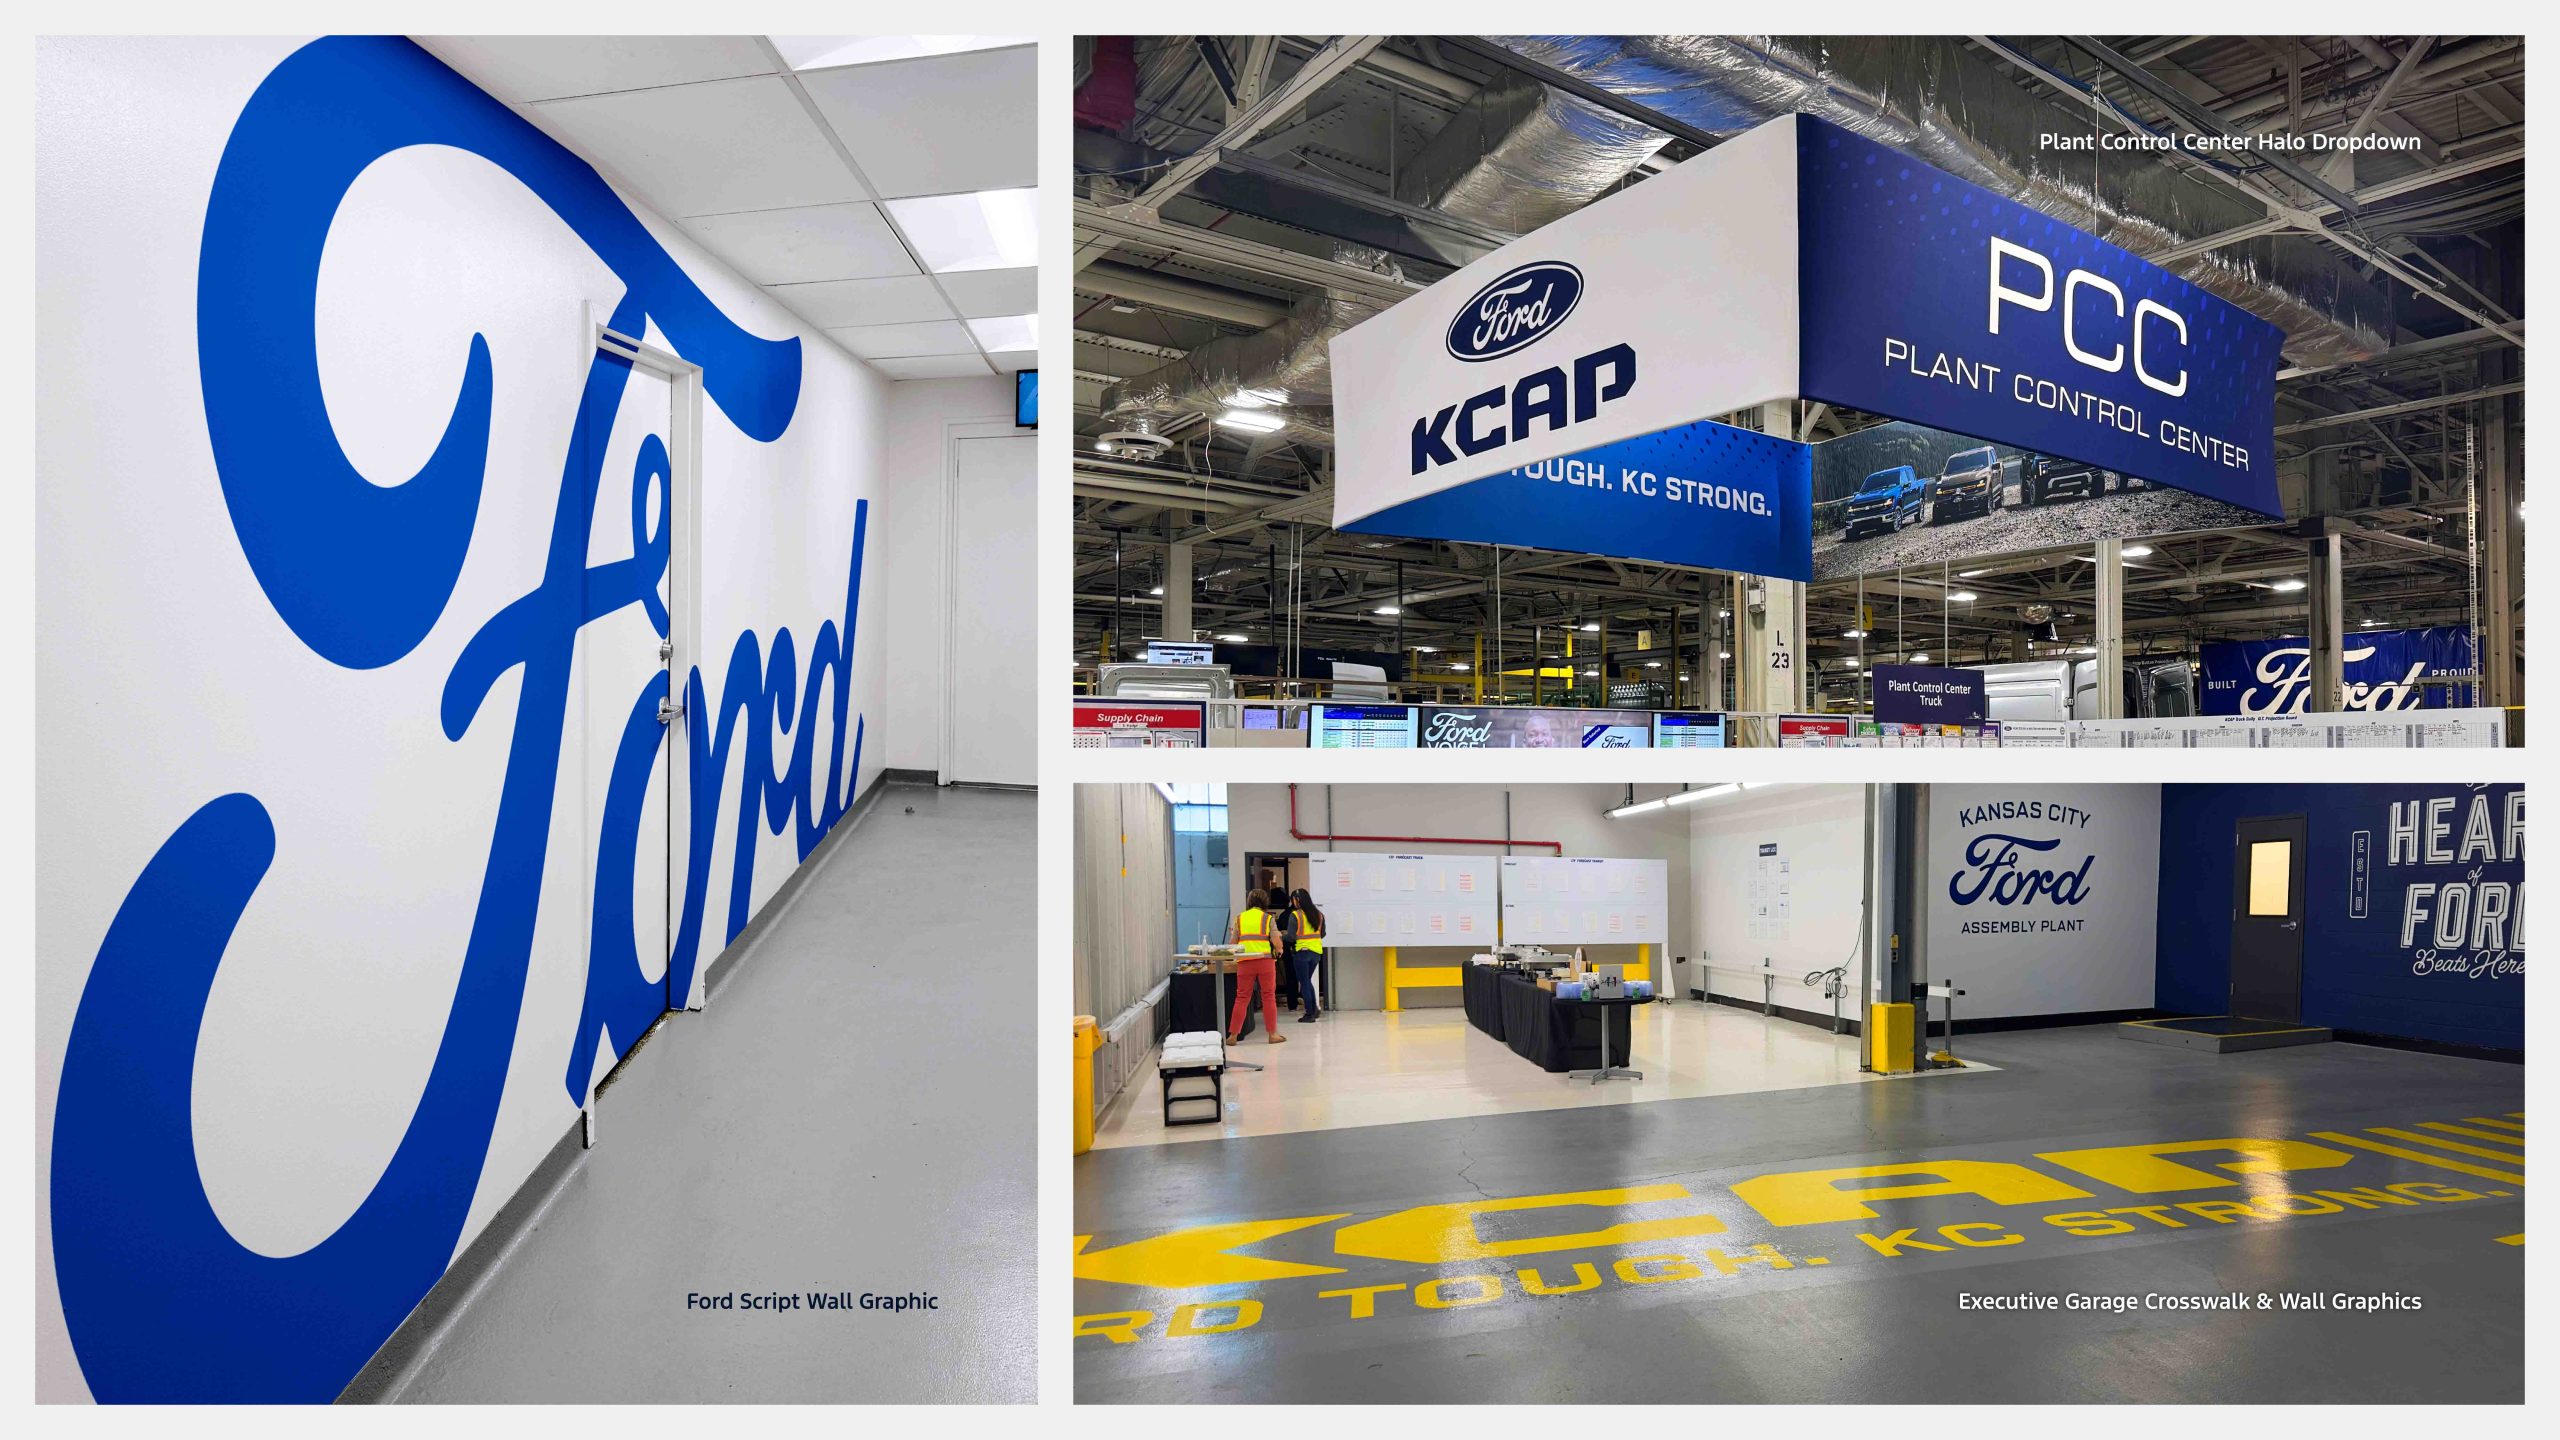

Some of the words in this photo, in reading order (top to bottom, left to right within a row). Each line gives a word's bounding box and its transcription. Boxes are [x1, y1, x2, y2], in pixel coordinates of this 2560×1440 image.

[1472, 278, 1554, 351] Ford
[1989, 236, 2188, 397] PCC
[1411, 342, 1637, 476] KCAP
[1885, 337, 2001, 393] PLANT
[2014, 373, 2150, 439] CONTROL
[2160, 420, 2249, 472] CENTER
[1622, 468, 1657, 496] KC
[1665, 476, 1772, 517] STRONG.
[1776, 630, 1784, 646] L
[1771, 652, 1790, 669] 23
[1888, 680, 1911, 692] Plant
[1912, 681, 1943, 694] Control
[1944, 682, 1972, 695] Center
[2208, 680, 2237, 689] BUILT
[1919, 695, 1943, 706] Truck
[51, 35, 869, 1404] Ford
[1097, 713, 1132, 723] Supply
[1135, 713, 1164, 722] Chain
[1424, 712, 1492, 742] Ford
[1959, 801, 2042, 828] KANSAS
[2048, 804, 2092, 829] CITY
[1949, 833, 2096, 906] Ford
[2467, 865, 2483, 886] of
[1961, 920, 2037, 934] ASSEMBLY
[2041, 919, 2085, 932] PLANT
[2412, 949, 2471, 976] Beats
[1318, 1243, 1833, 1319] TOUGH.
[1856, 1222, 2025, 1257] KC
[2042, 1182, 2516, 1236] STRONG.
